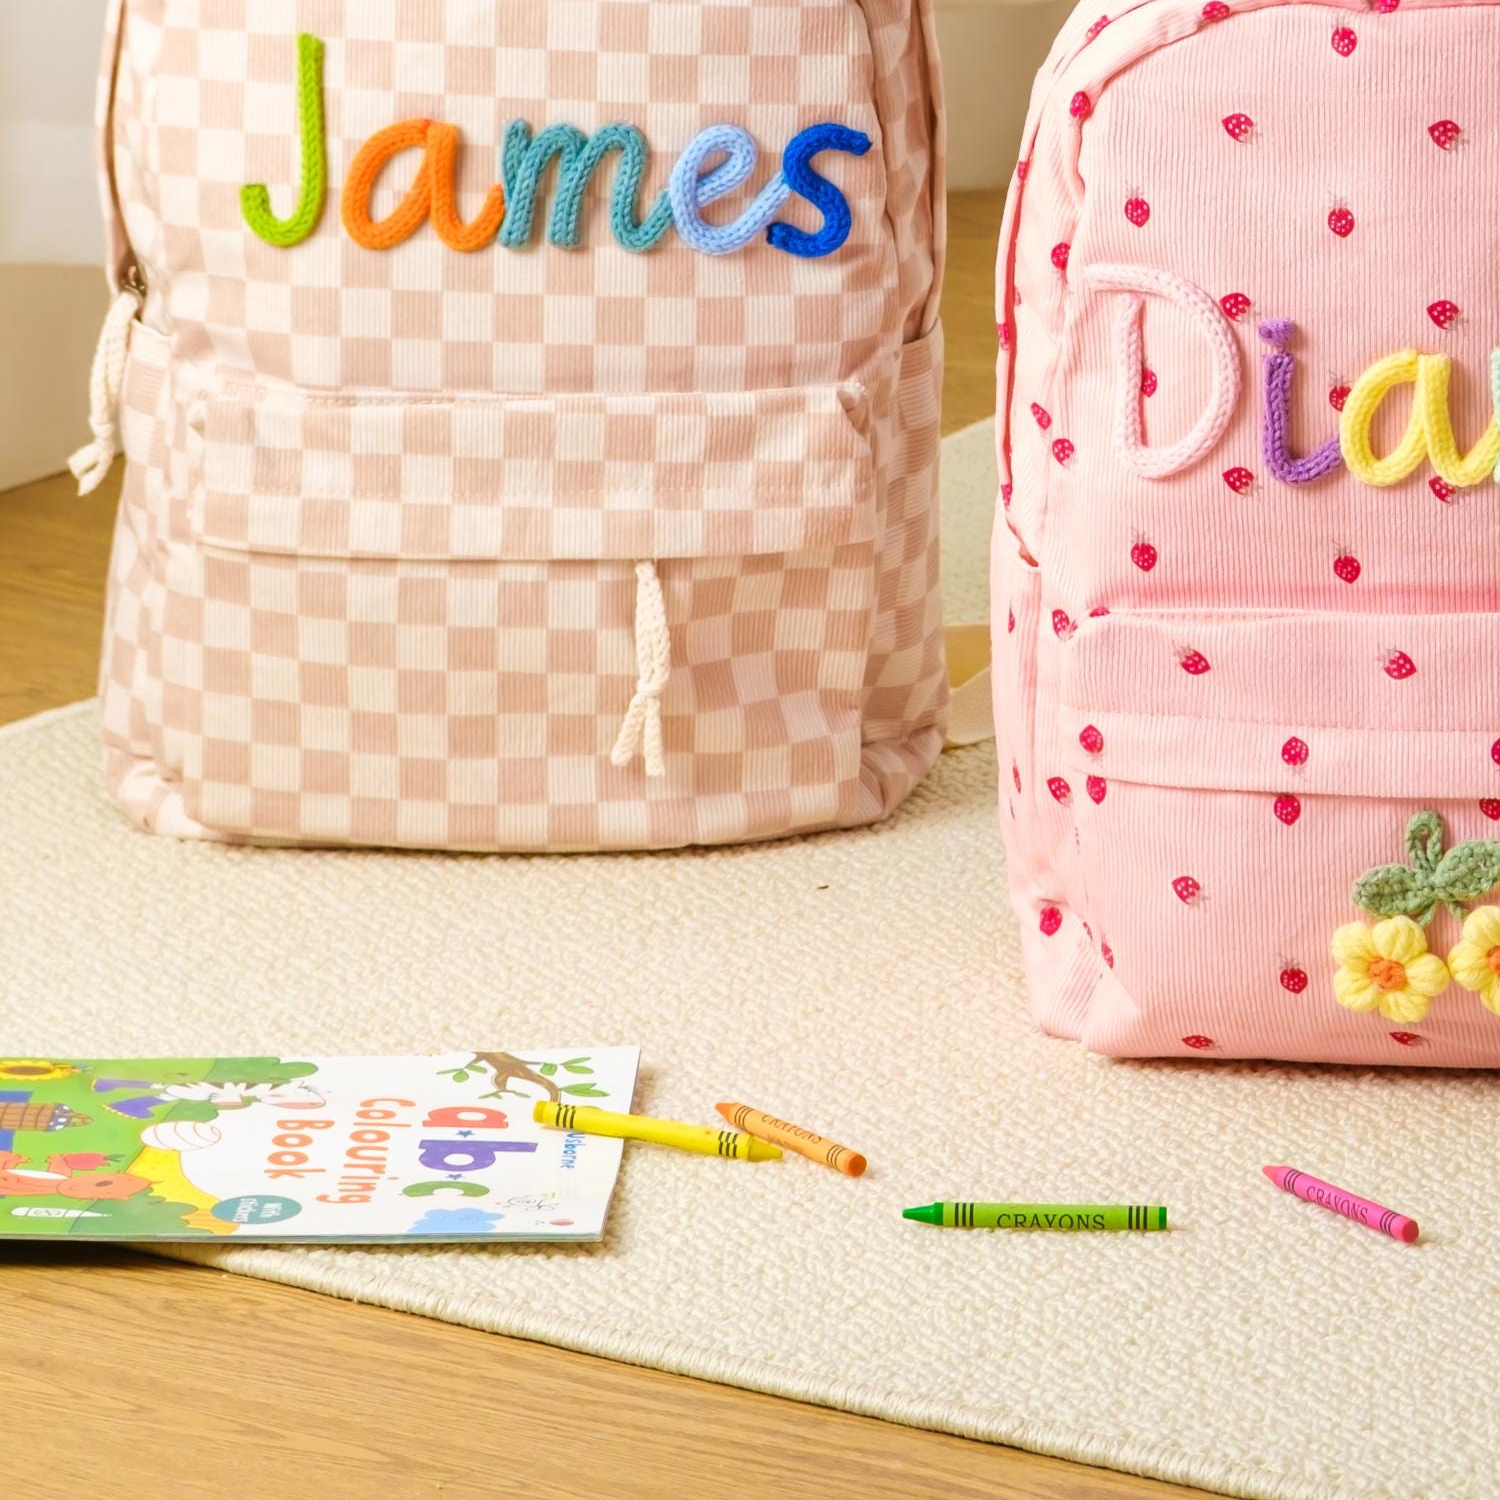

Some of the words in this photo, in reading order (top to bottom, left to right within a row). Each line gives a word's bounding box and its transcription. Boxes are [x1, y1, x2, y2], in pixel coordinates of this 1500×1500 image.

[240, 33, 872, 258] James
[264, 1119, 335, 1179] Book
[317, 1099, 415, 1204] Colouring
[996, 1213, 1105, 1230] CRAYONS
